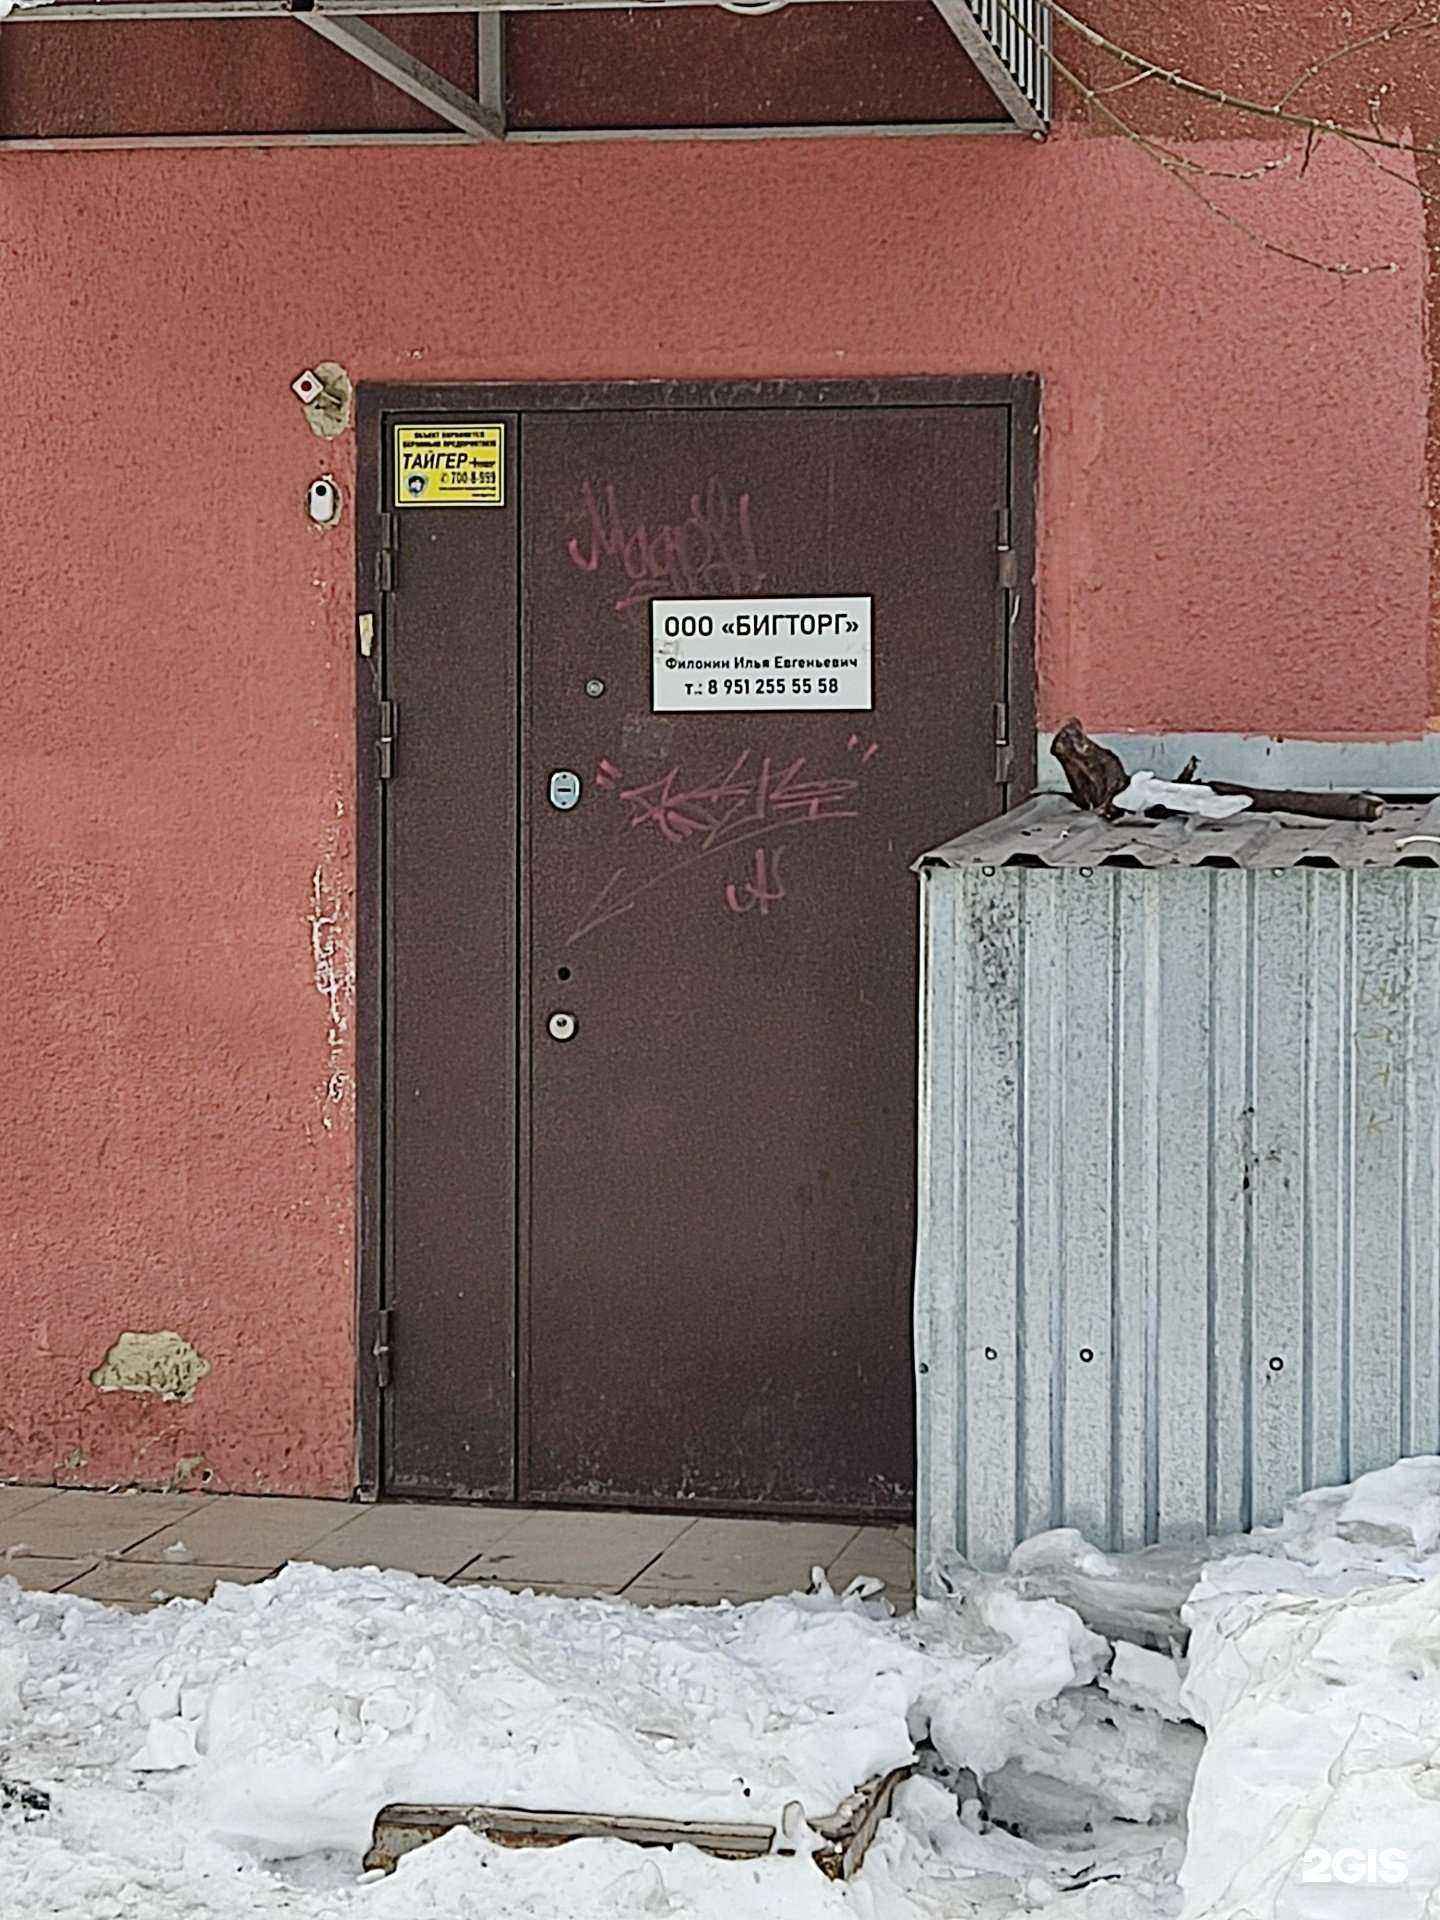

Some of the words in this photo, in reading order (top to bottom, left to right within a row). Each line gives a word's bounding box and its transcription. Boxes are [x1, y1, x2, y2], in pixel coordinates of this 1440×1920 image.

[403, 450, 468, 470] ТАЙГЕР
[664, 615, 714, 637] ООО
[721, 613, 860, 636] «БИГТОРГ»
[665, 656, 731, 670] Филонин
[734, 655, 770, 669] Илья
[774, 655, 858, 669] Евгеньевич
[707, 678, 719, 696] 8
[723, 678, 751, 696] 951
[755, 677, 786, 695] 255
[791, 677, 813, 694] 55
[817, 677, 839, 694] 58
